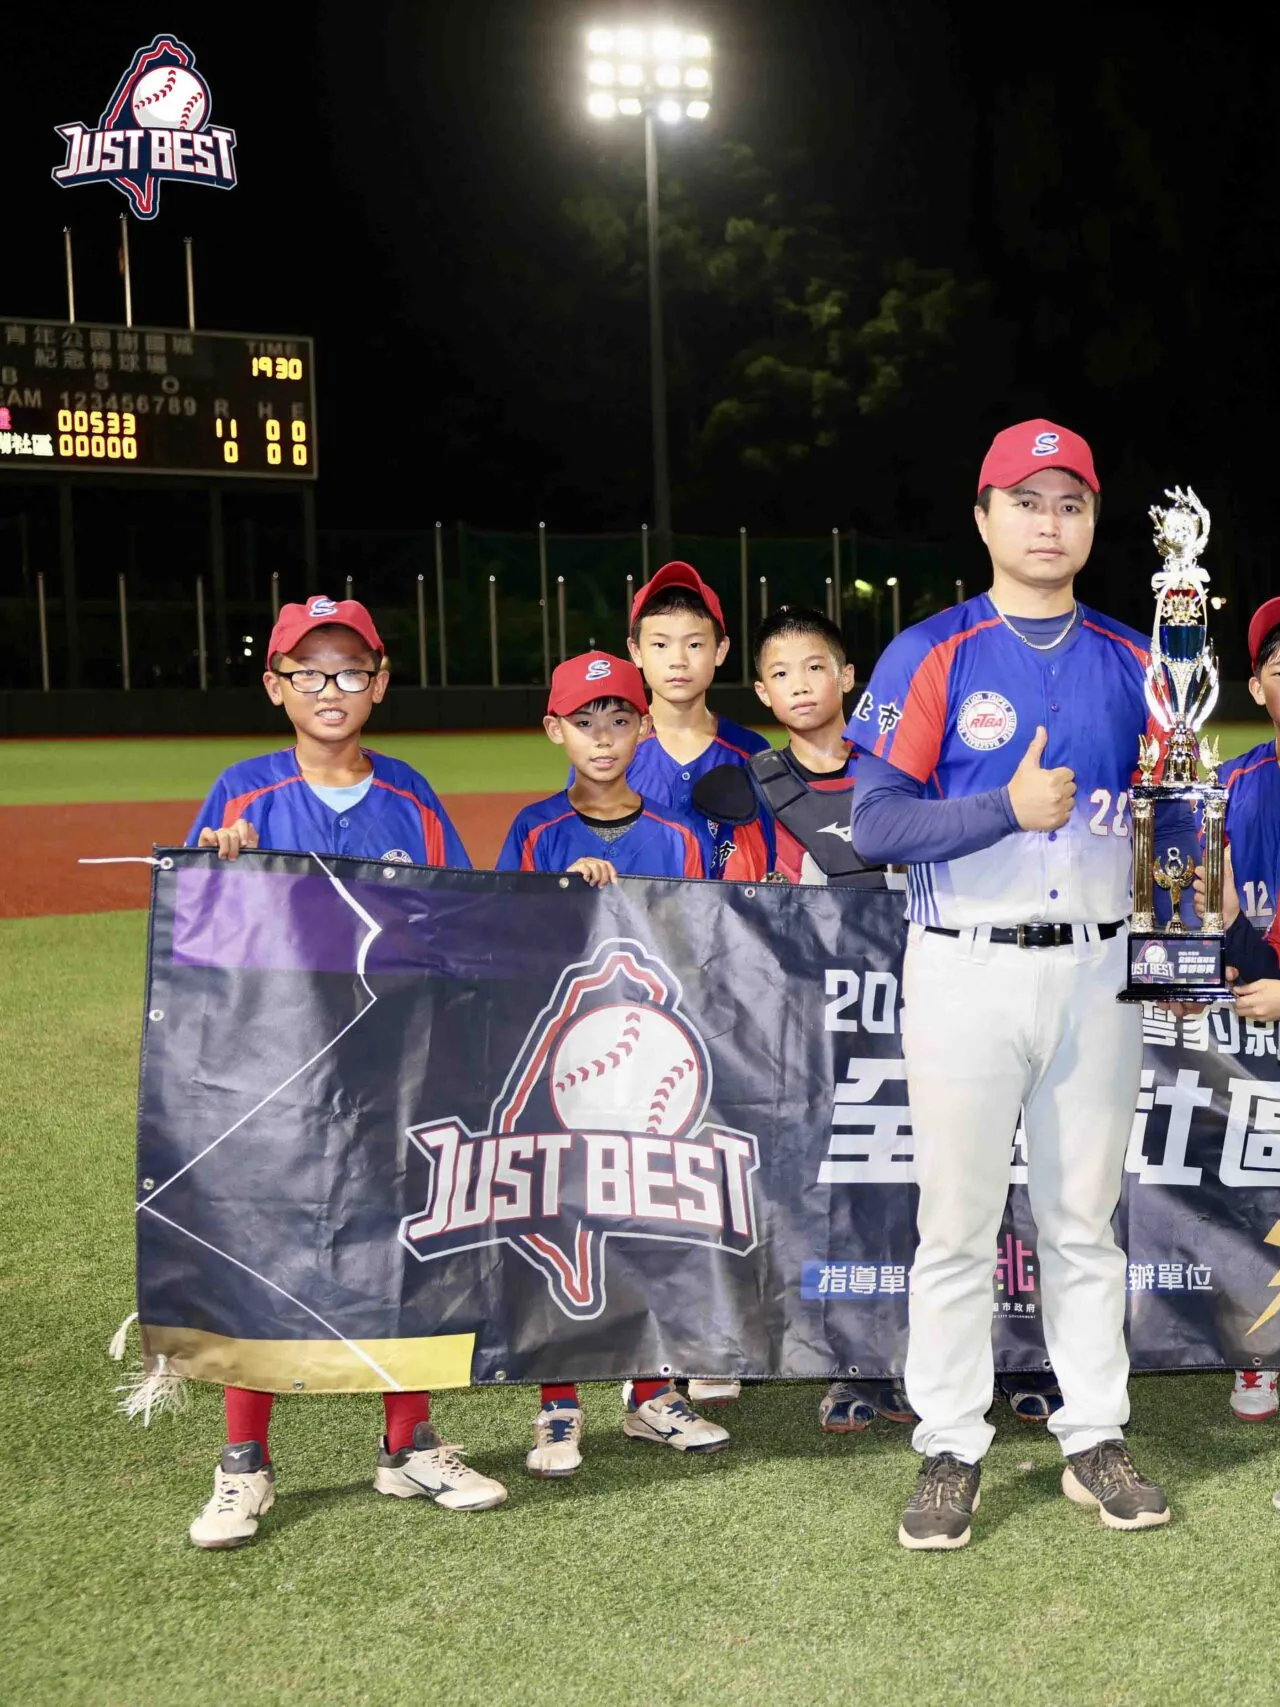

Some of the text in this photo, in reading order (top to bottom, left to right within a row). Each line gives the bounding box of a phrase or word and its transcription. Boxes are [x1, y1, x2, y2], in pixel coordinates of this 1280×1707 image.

[245, 340, 298, 356] TIME
[2, 365, 18, 386] B
[252, 356, 303, 380] 1930
[0, 387, 42, 408] AM
[214, 398, 230, 418] R
[258, 401, 273, 419] H
[291, 402, 304, 420] E
[58, 409, 306, 442] 00533 11 0 0
[59, 434, 137, 459] 00000
[223, 441, 239, 463] 0
[267, 442, 282, 465] 0
[292, 444, 307, 466] 0
[1032, 433, 1059, 456] S
[309, 599, 337, 617] S
[586, 660, 611, 680] S
[970, 713, 1003, 728] RTBA
[1243, 881, 1273, 917] 12
[1131, 962, 1174, 978] UST BEST
[825, 969, 906, 1034] 20
[408, 1125, 752, 1241] JUST BEST
[818, 1265, 912, 1295] 指導單
[1125, 1263, 1213, 1291] 辦單位
